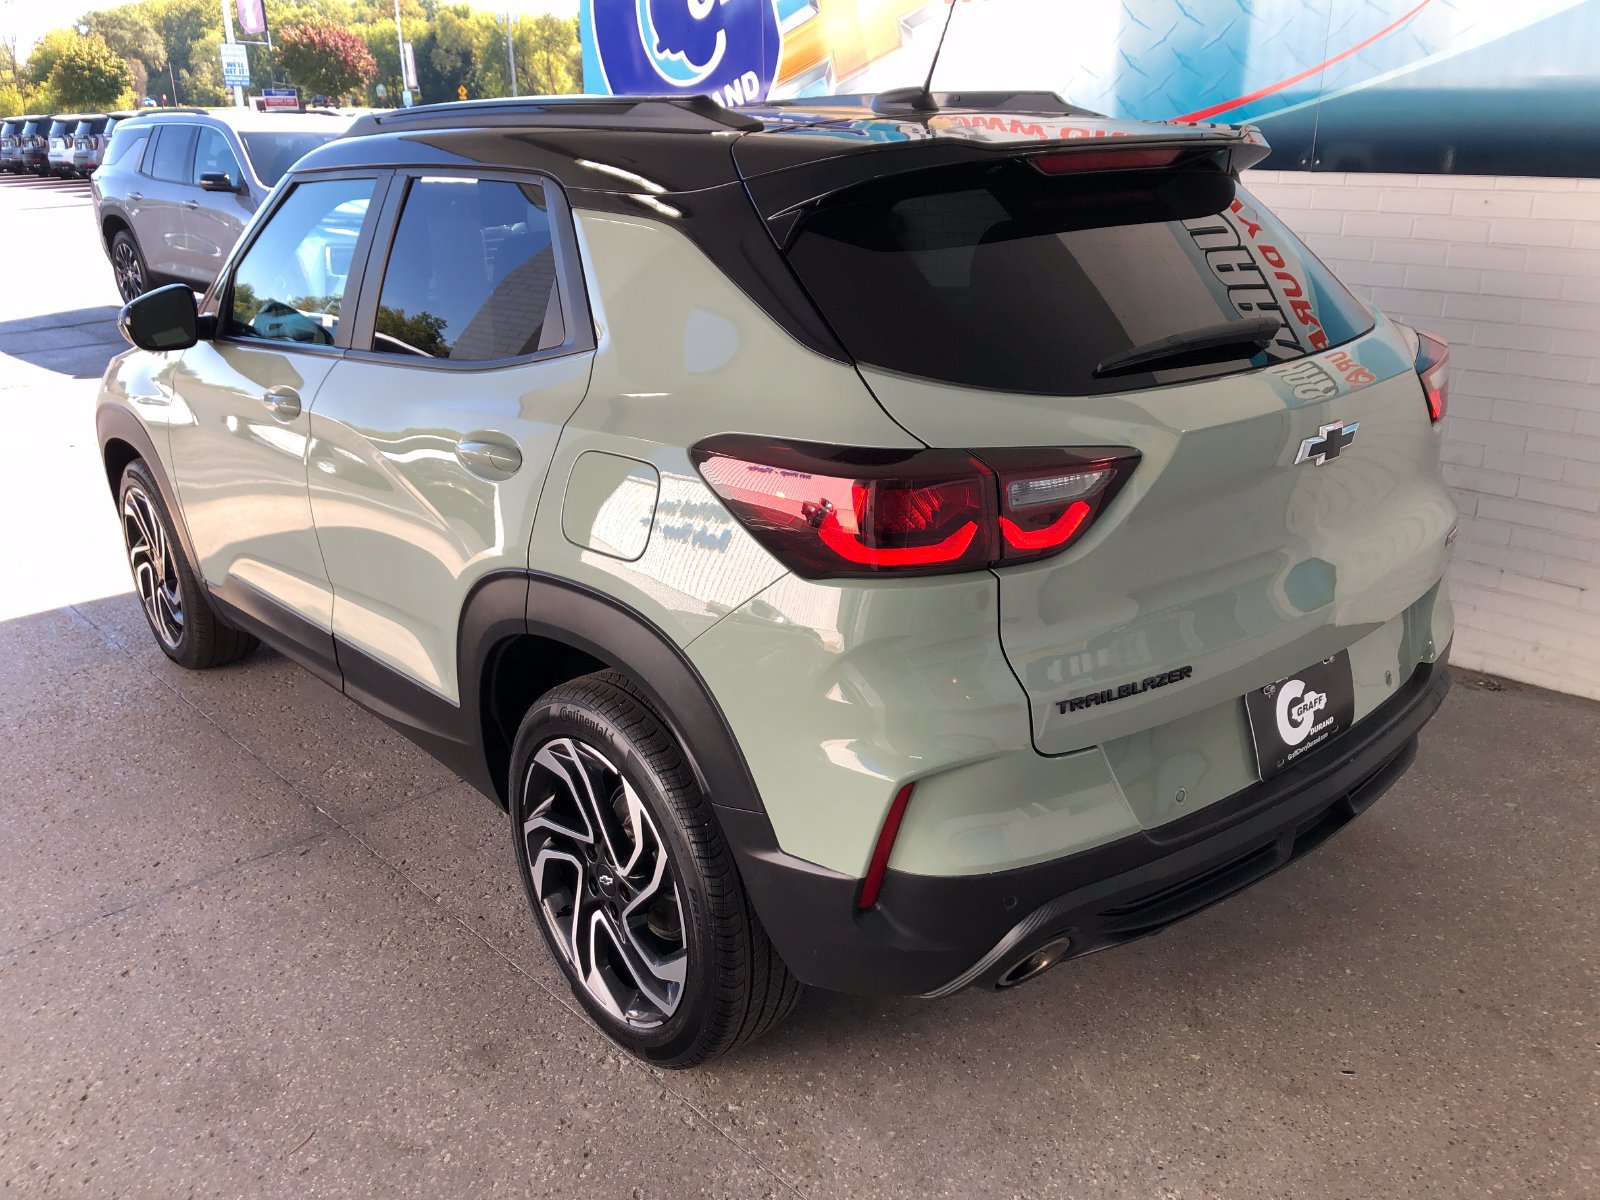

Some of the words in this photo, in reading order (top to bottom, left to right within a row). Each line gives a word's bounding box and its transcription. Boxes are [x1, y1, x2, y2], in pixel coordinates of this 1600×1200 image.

[1056, 665, 1192, 714] TRAILBLAZER
[1296, 695, 1324, 716] GRAFF
[559, 706, 609, 739] Continental
[1309, 716, 1334, 735] DURAND
